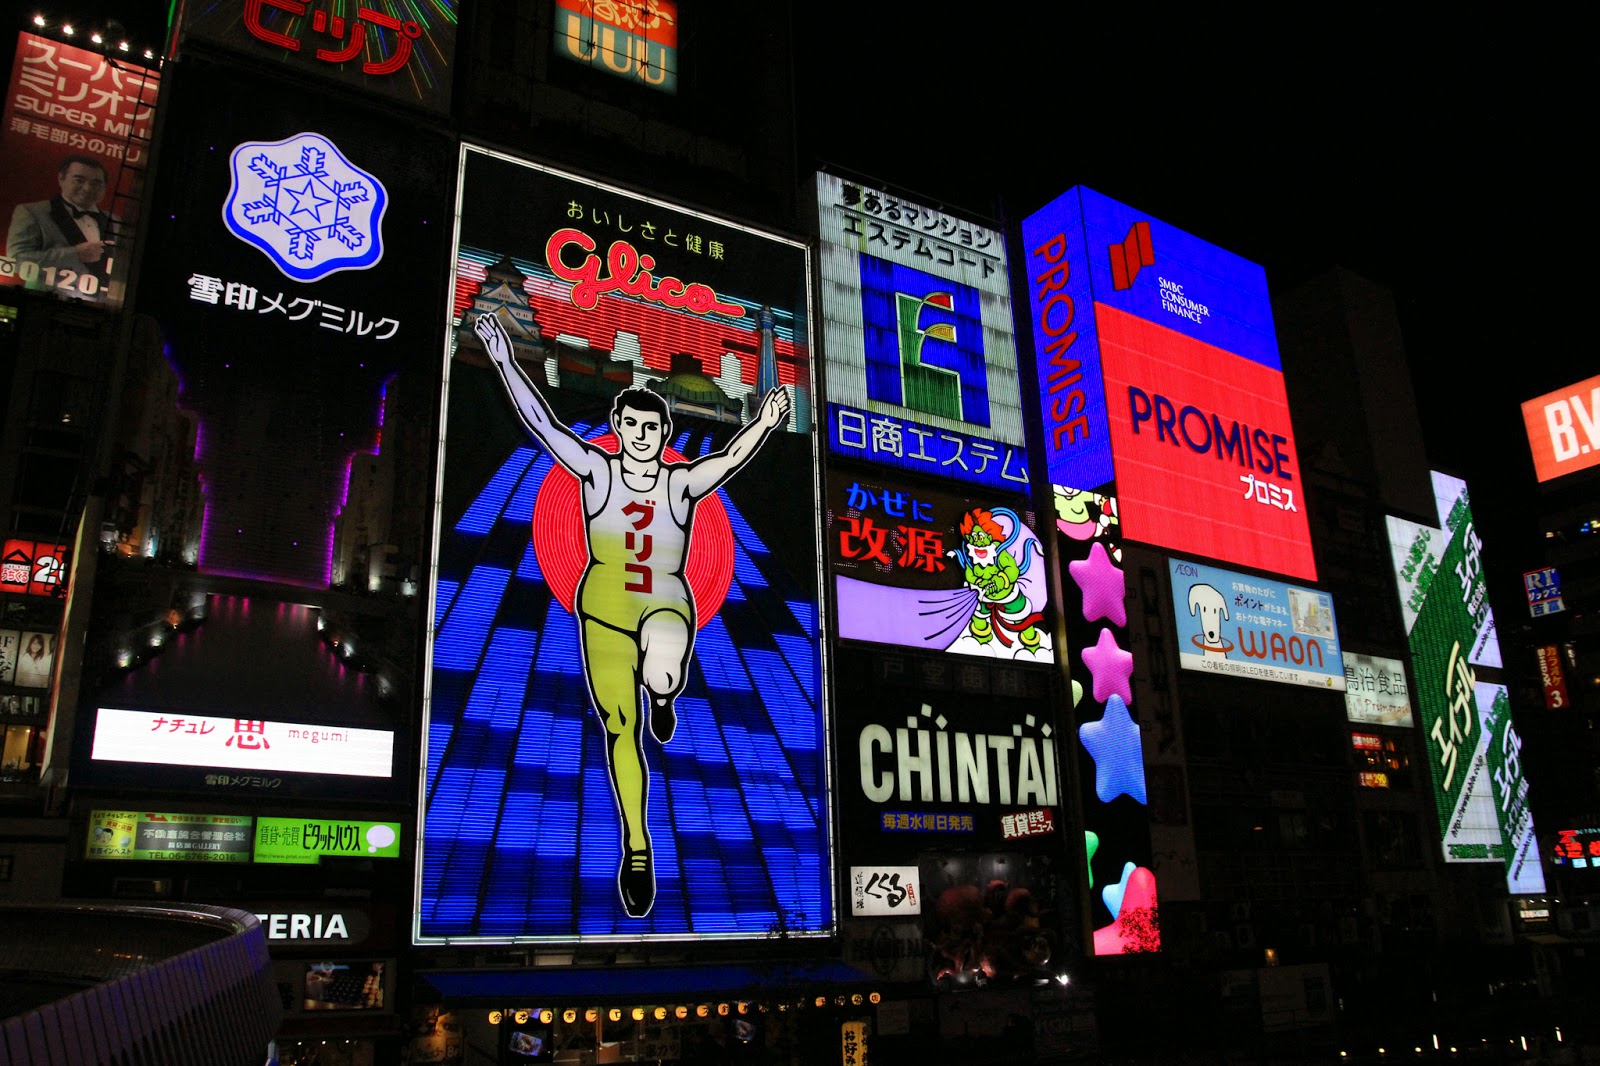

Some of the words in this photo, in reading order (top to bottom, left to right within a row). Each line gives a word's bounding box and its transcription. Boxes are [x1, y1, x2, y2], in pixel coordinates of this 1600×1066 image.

[23, 39, 157, 90] スーパー
[15, 94, 97, 128] SUPER
[19, 66, 152, 120] ミリオン
[567, 200, 724, 260] おいしさと健康
[842, 183, 992, 249] 夢あるマンション
[843, 214, 995, 279] エステムコート
[546, 228, 746, 317] Glico
[1158, 277, 1184, 296] SMBC
[187, 273, 400, 340] 雪印メグミルク
[1160, 288, 1210, 317] CONSUMER
[1162, 300, 1202, 325] FINANCE
[1033, 232, 1090, 450] PROMISE
[838, 409, 1029, 484] 日商エステム
[1128, 385, 1294, 481] PROMISE
[845, 481, 934, 523] かぜに
[1239, 474, 1298, 513] プロミス
[621, 499, 656, 594] グリコ
[837, 515, 946, 573] 改源
[1455, 521, 1483, 603] エイブル
[1, 568, 29, 583] うちくる
[1237, 626, 1324, 668] WAON
[1545, 645, 1562, 687] カラオケ
[1430, 640, 1476, 792] エイブル
[1551, 690, 1563, 708] 3
[151, 716, 216, 735] ナチュレ
[288, 728, 349, 744] megumi
[205, 773, 282, 789] 雪印メグミルク
[1493, 719, 1522, 813] エイブル
[303, 823, 361, 851] ピタットハウス
[883, 813, 974, 831] 毎週水曜日発売
[1001, 813, 1031, 838] 賃貸
[1028, 810, 1044, 824] 住宅
[1031, 819, 1054, 833] ニュース
[864, 872, 907, 909] くくる
